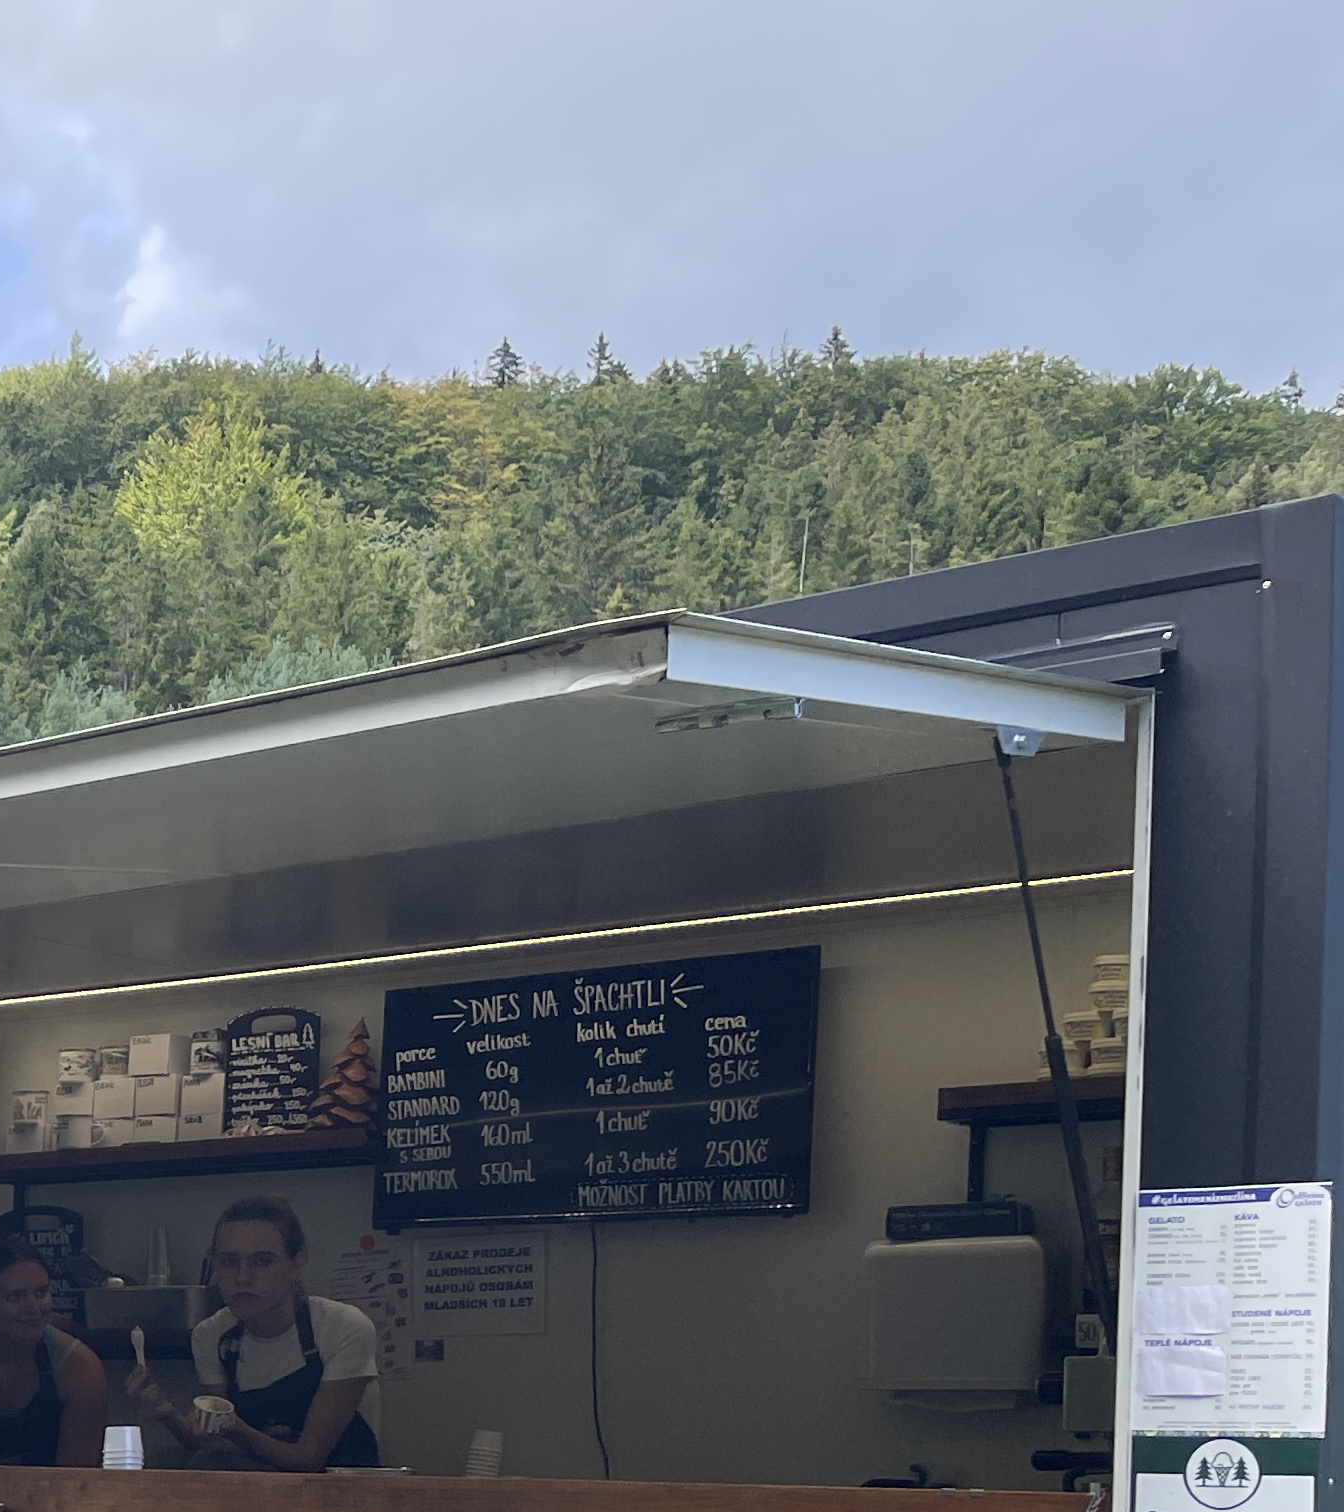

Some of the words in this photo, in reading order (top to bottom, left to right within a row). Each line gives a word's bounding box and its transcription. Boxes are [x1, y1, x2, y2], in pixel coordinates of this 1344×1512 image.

[468, 993, 520, 1027] DNES
[533, 990, 559, 1018] NA
[573, 978, 666, 1016] ŠPACHTLI
[274, 1033, 300, 1048] BAR
[395, 1046, 437, 1071] porce
[466, 1032, 531, 1056] velikost
[576, 1021, 617, 1043] kolik
[626, 1014, 666, 1038] chutí
[704, 1014, 747, 1032] cena
[387, 1069, 446, 1094] BAMBINI
[485, 1060, 519, 1084] 60g
[706, 1029, 760, 1059] 50Kč
[387, 1095, 460, 1121] STANDARD
[479, 1089, 520, 1116] 120g
[708, 1060, 760, 1088] 85Kč
[386, 1120, 451, 1149] KELÍMEK
[480, 1122, 534, 1148] 160ml
[709, 1096, 761, 1125] 90Kč
[399, 1150, 409, 1164] S
[412, 1145, 452, 1162] SEBOU
[479, 1159, 536, 1187] 550ml
[704, 1138, 771, 1169] 250Kč
[577, 1179, 649, 1207] MOŽNOST
[658, 1180, 713, 1204] PLATBY
[722, 1178, 785, 1202] KARTOU
[1148, 1216, 1185, 1225] GELATO
[1234, 1213, 1260, 1222] KÁVA
[473, 1246, 531, 1259] PRODEJE
[509, 1297, 534, 1307] LET
[1231, 1309, 1272, 1318] STUDENÉ
[1274, 1308, 1312, 1317] NÁPOJE
[1144, 1338, 1170, 1347] TEPLÉ
[1174, 1338, 1212, 1347] NÁPOJE
